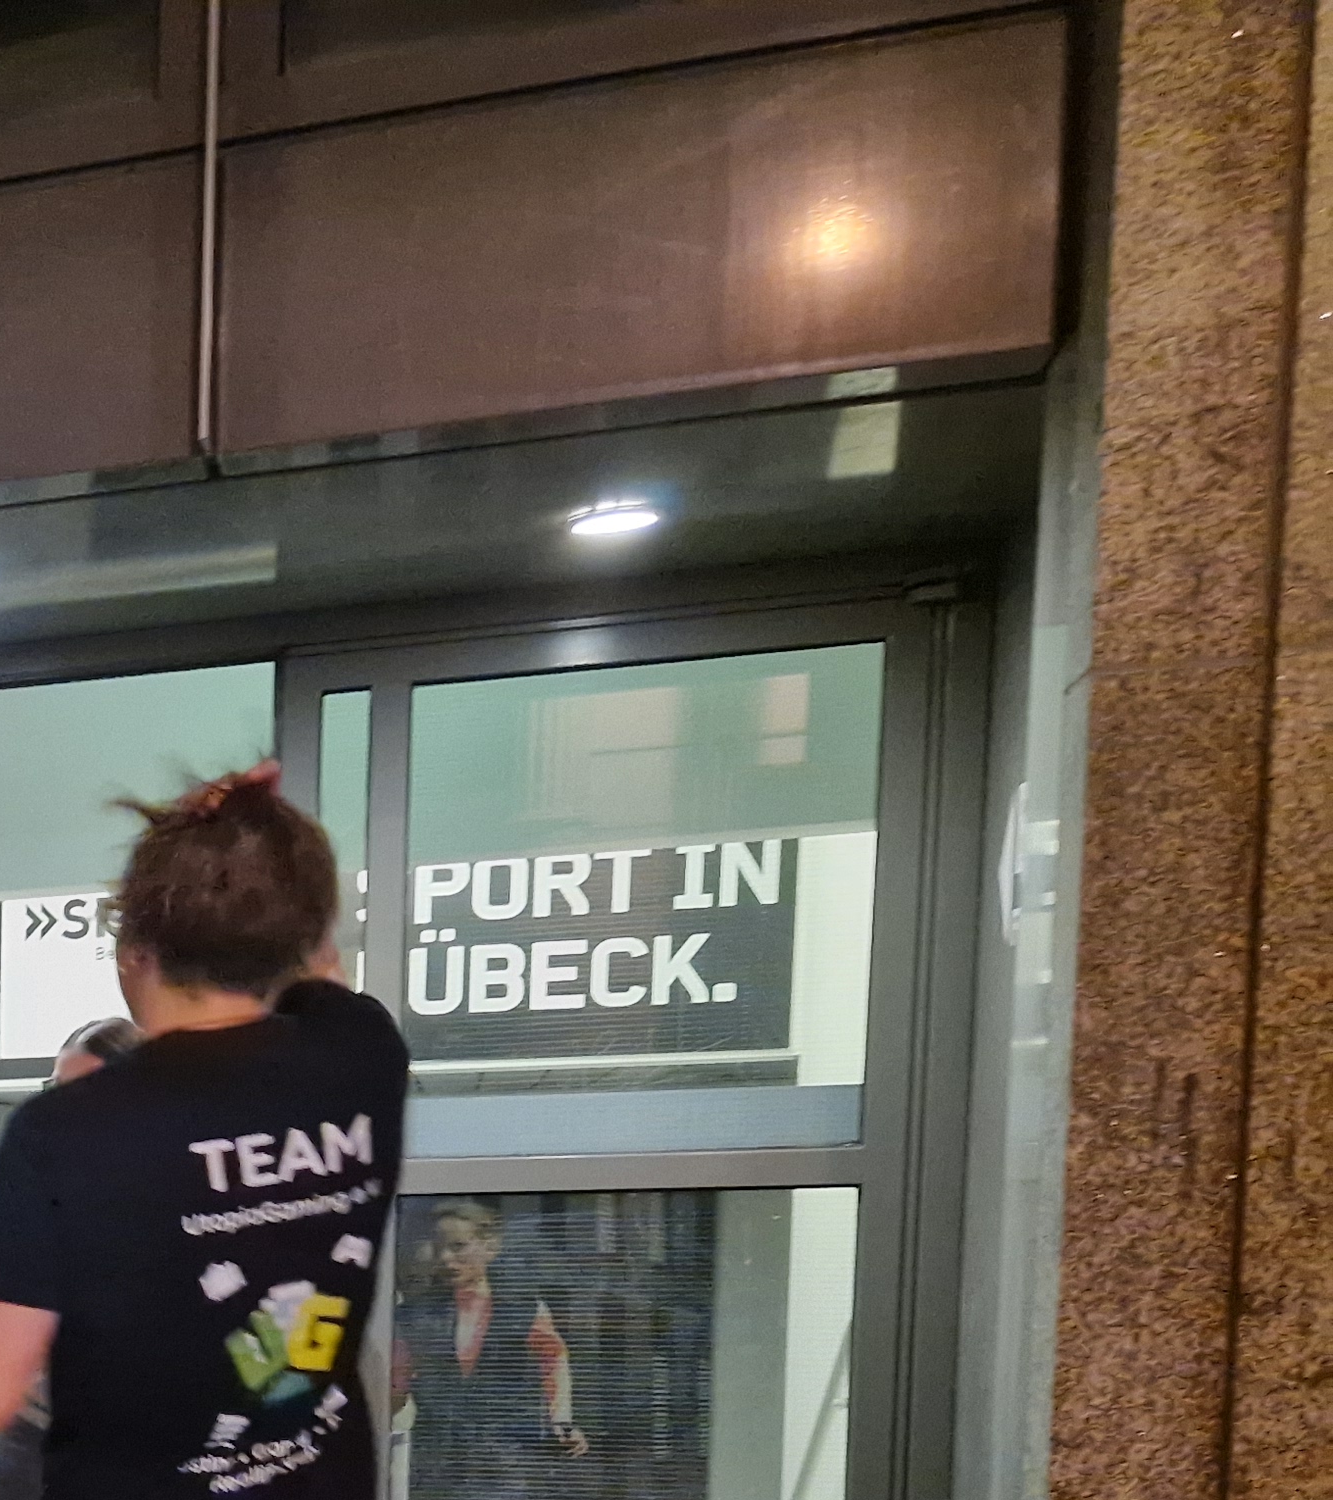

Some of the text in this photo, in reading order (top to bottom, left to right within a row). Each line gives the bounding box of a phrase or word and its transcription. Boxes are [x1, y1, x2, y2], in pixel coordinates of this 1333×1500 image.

[356, 838, 783, 926] PORT IN
[356, 927, 739, 1016] ÜBECK.
[188, 1112, 374, 1193] TEAM
